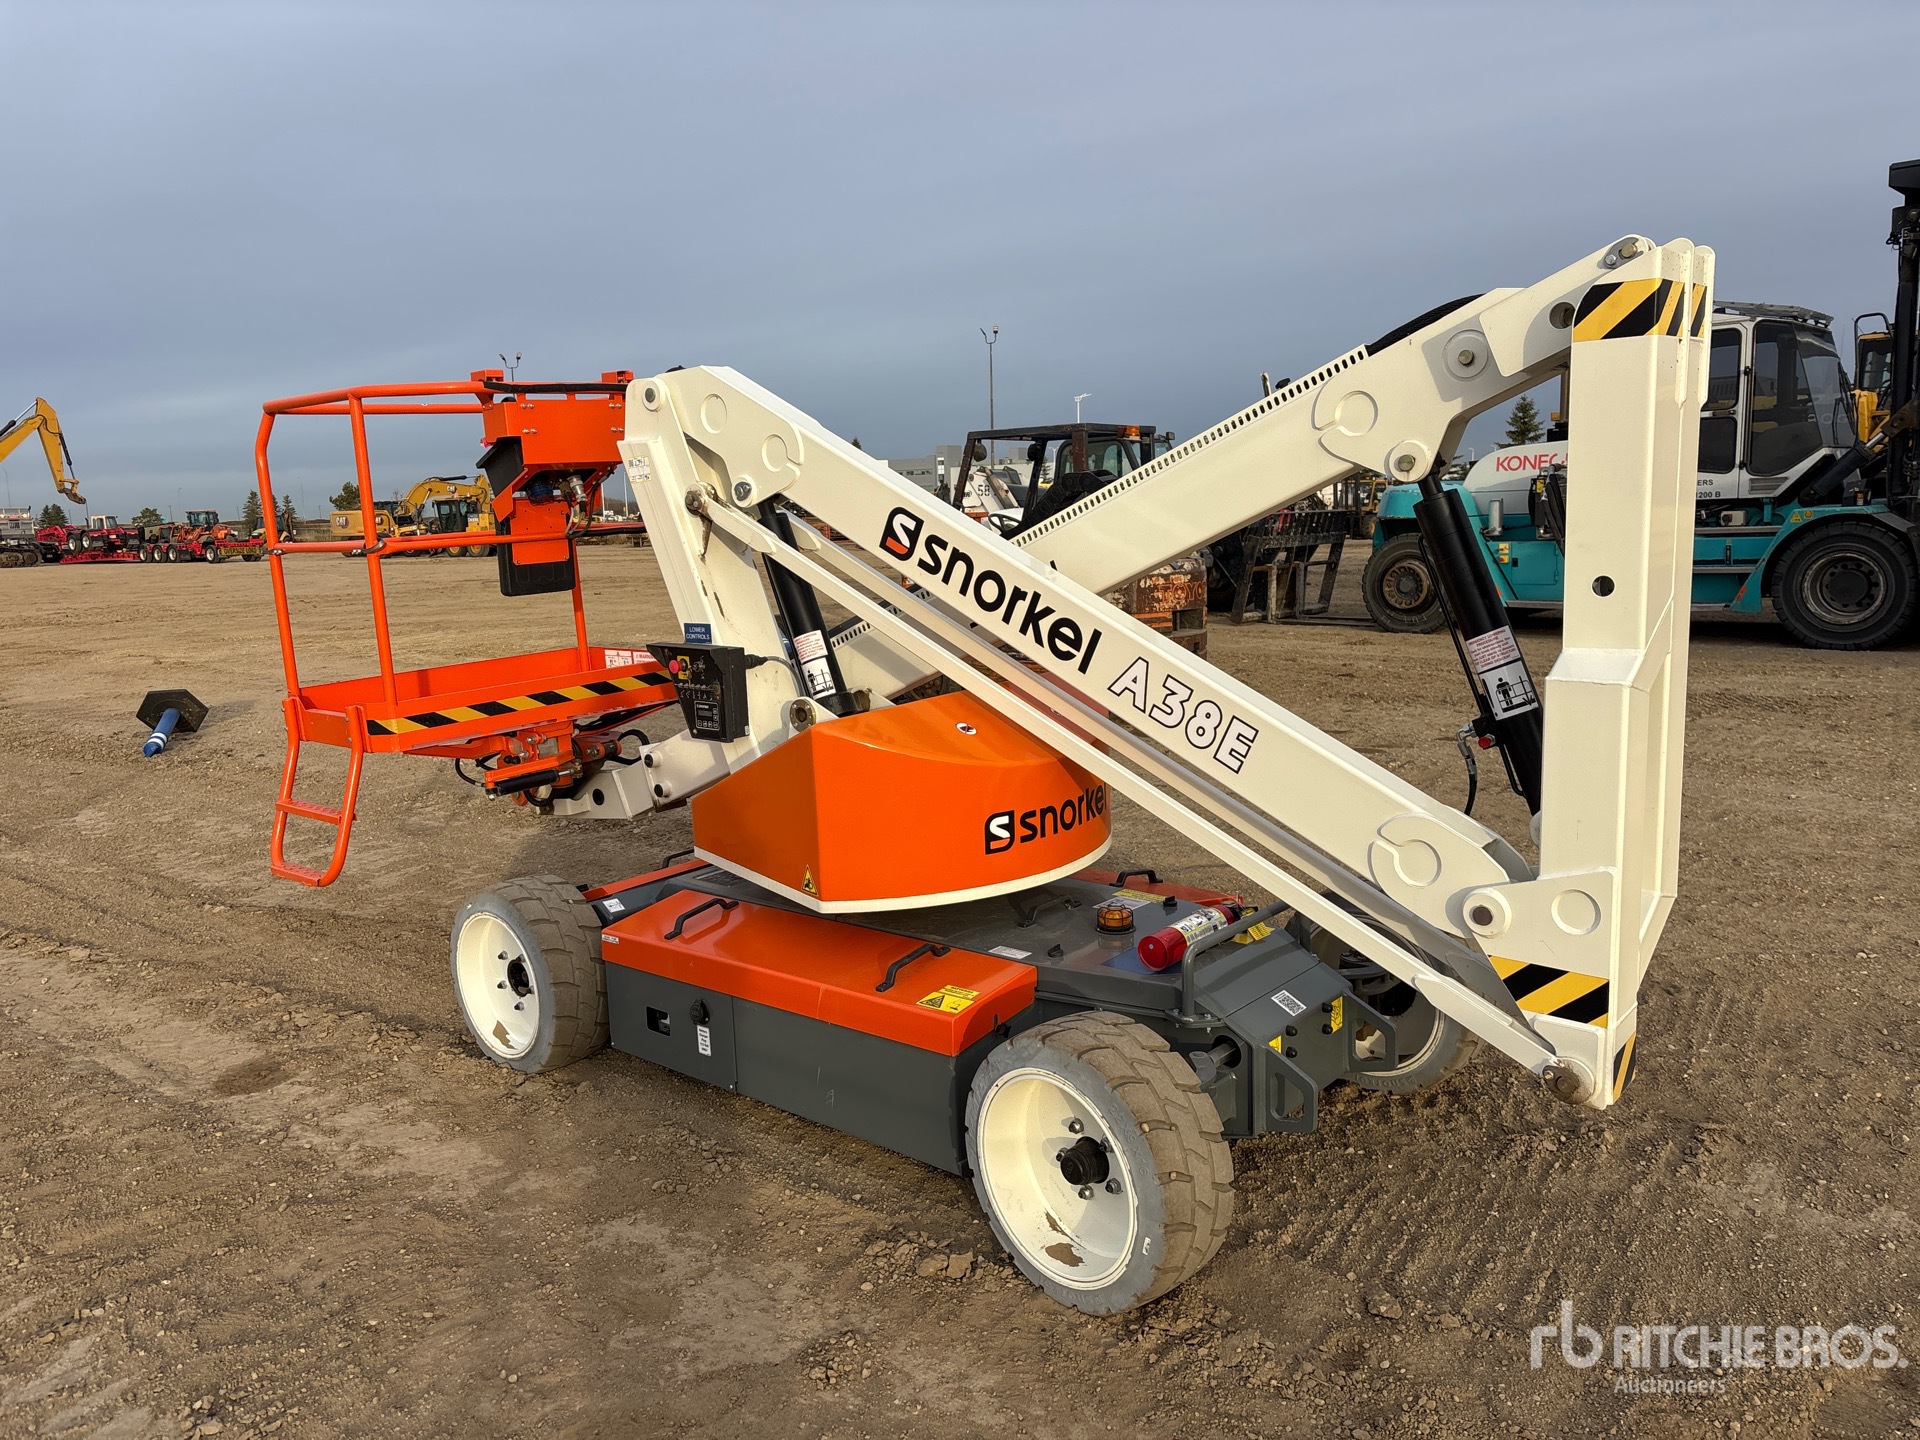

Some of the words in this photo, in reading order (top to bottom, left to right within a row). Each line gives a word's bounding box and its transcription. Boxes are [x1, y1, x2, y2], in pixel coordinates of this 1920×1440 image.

[1496, 453, 1569, 472] KONEC
[335, 516, 346, 526] CAT
[918, 533, 1102, 674] snorkel
[1108, 656, 1259, 774] A38E
[1020, 782, 1107, 843] snorkel
